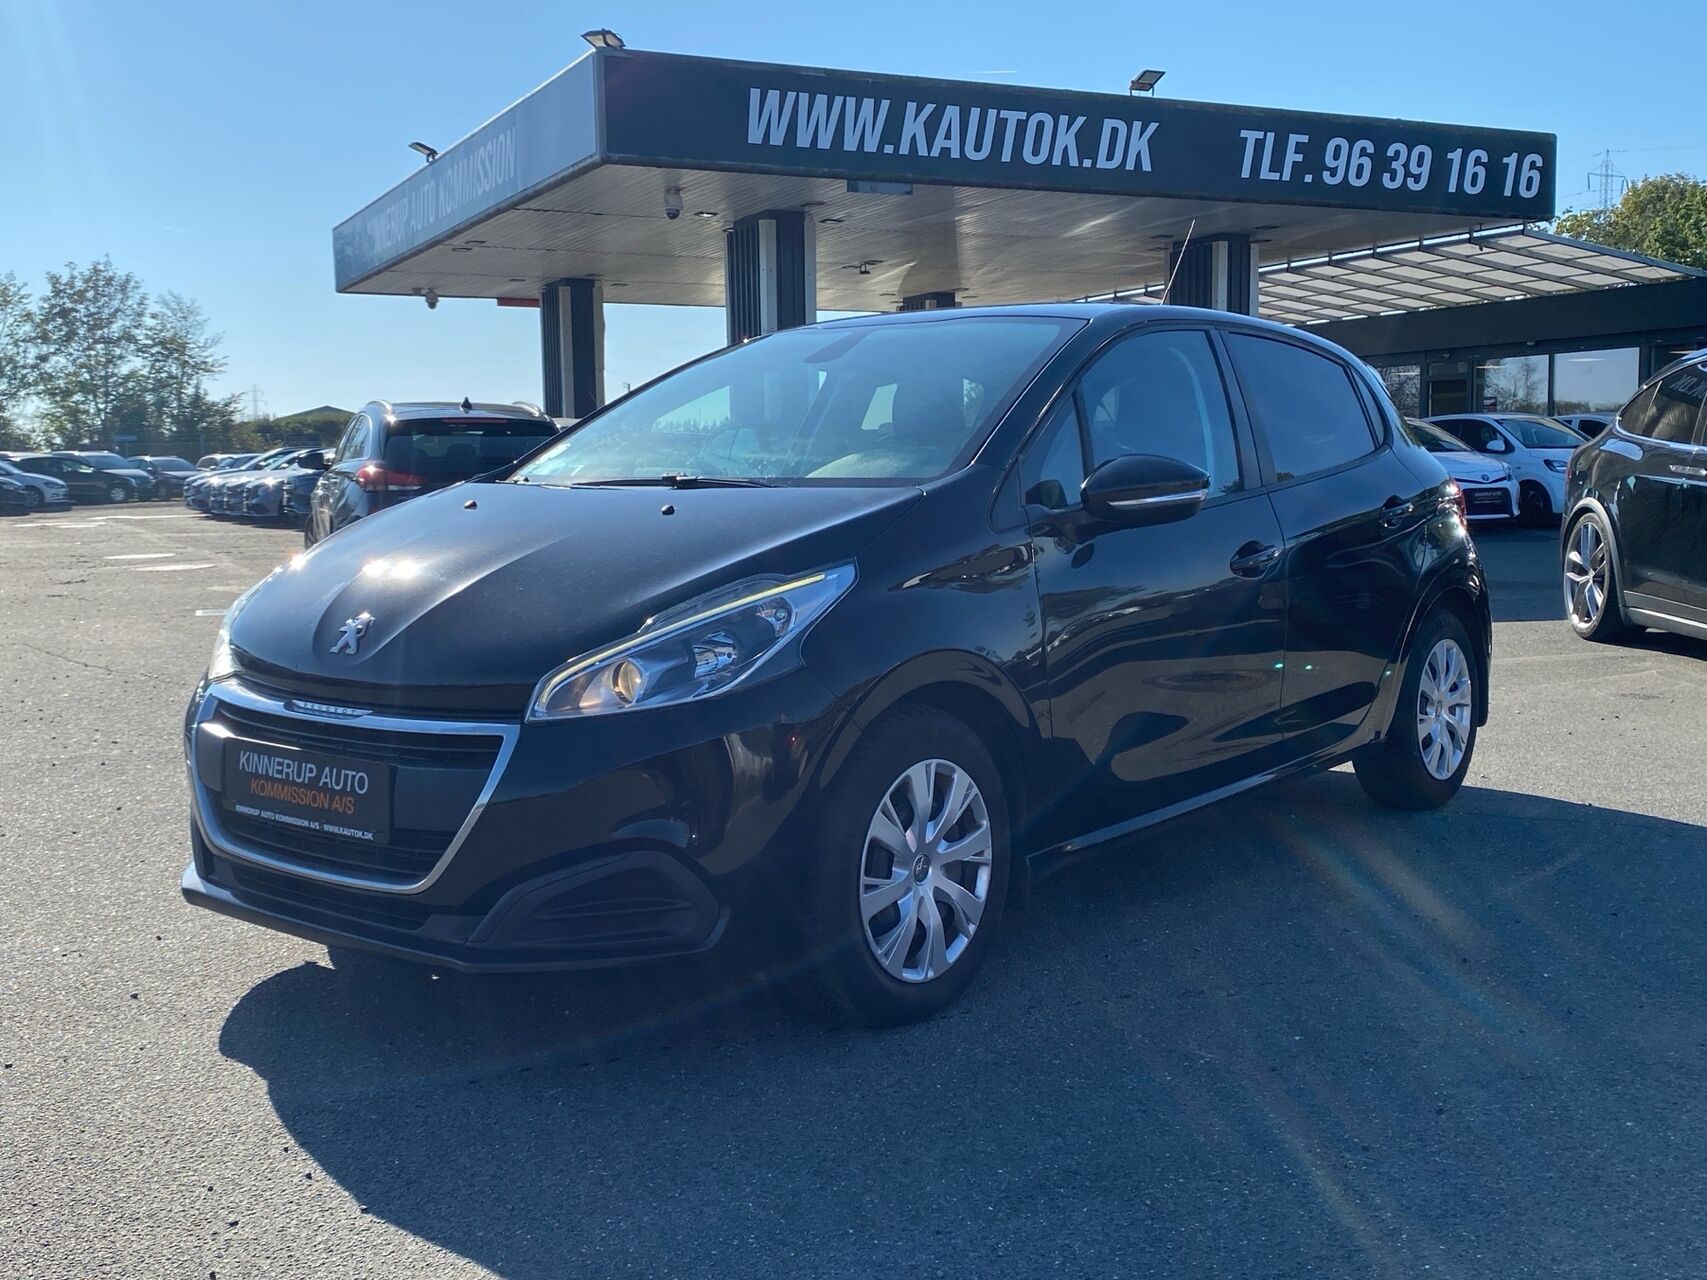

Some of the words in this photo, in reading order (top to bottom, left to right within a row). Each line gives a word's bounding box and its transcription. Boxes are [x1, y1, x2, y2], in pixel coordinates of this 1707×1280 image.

[747, 87, 1160, 172] WWW.KAUTOK.DK
[409, 178, 436, 234] AUTO
[438, 126, 517, 219] KOMMISSION
[1239, 129, 1313, 183] TLF.
[1322, 137, 1375, 187] 96
[1382, 142, 1433, 191] 39
[1447, 148, 1489, 195] 16
[1502, 152, 1544, 199] 16
[303, 702, 356, 715] PEUGEOT
[239, 750, 317, 784] KINNERUP
[319, 766, 369, 795] AUTO
[250, 778, 329, 809] KOMMISSION
[331, 794, 355, 815] A/S
[260, 809, 275, 820] AUTO
[310, 820, 320, 830] A/S
